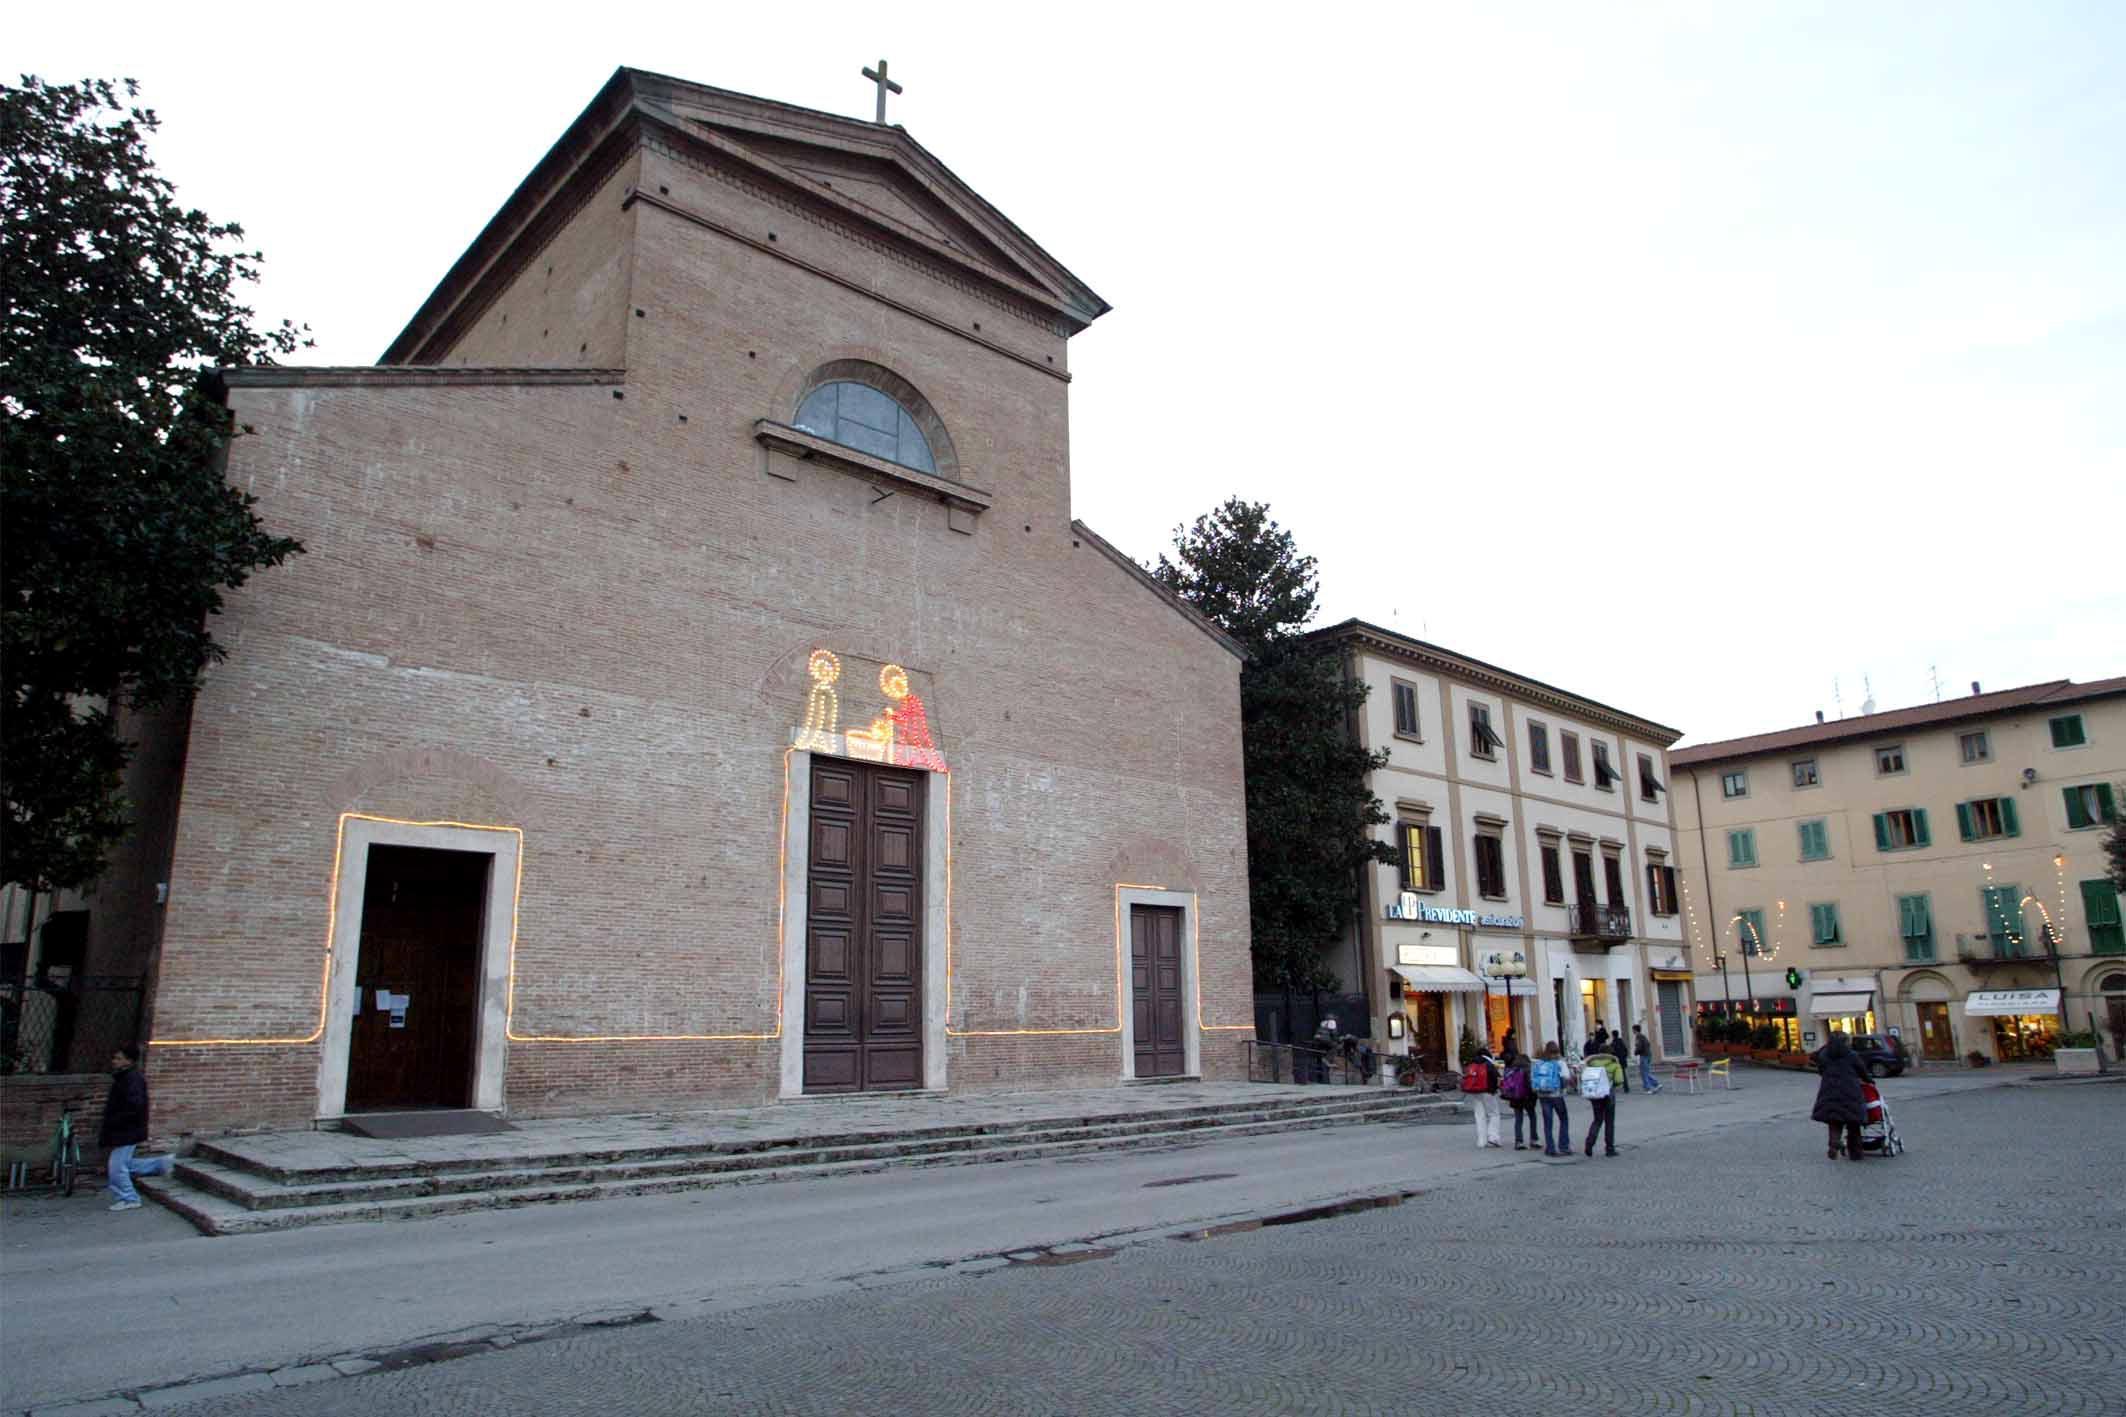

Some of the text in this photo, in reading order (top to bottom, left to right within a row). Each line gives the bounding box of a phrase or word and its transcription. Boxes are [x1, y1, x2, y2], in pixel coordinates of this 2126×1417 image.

[1389, 903, 1402, 918] LA
[1418, 899, 1477, 924] PREVIDENTE
[1979, 992, 2048, 1000] LUISA
